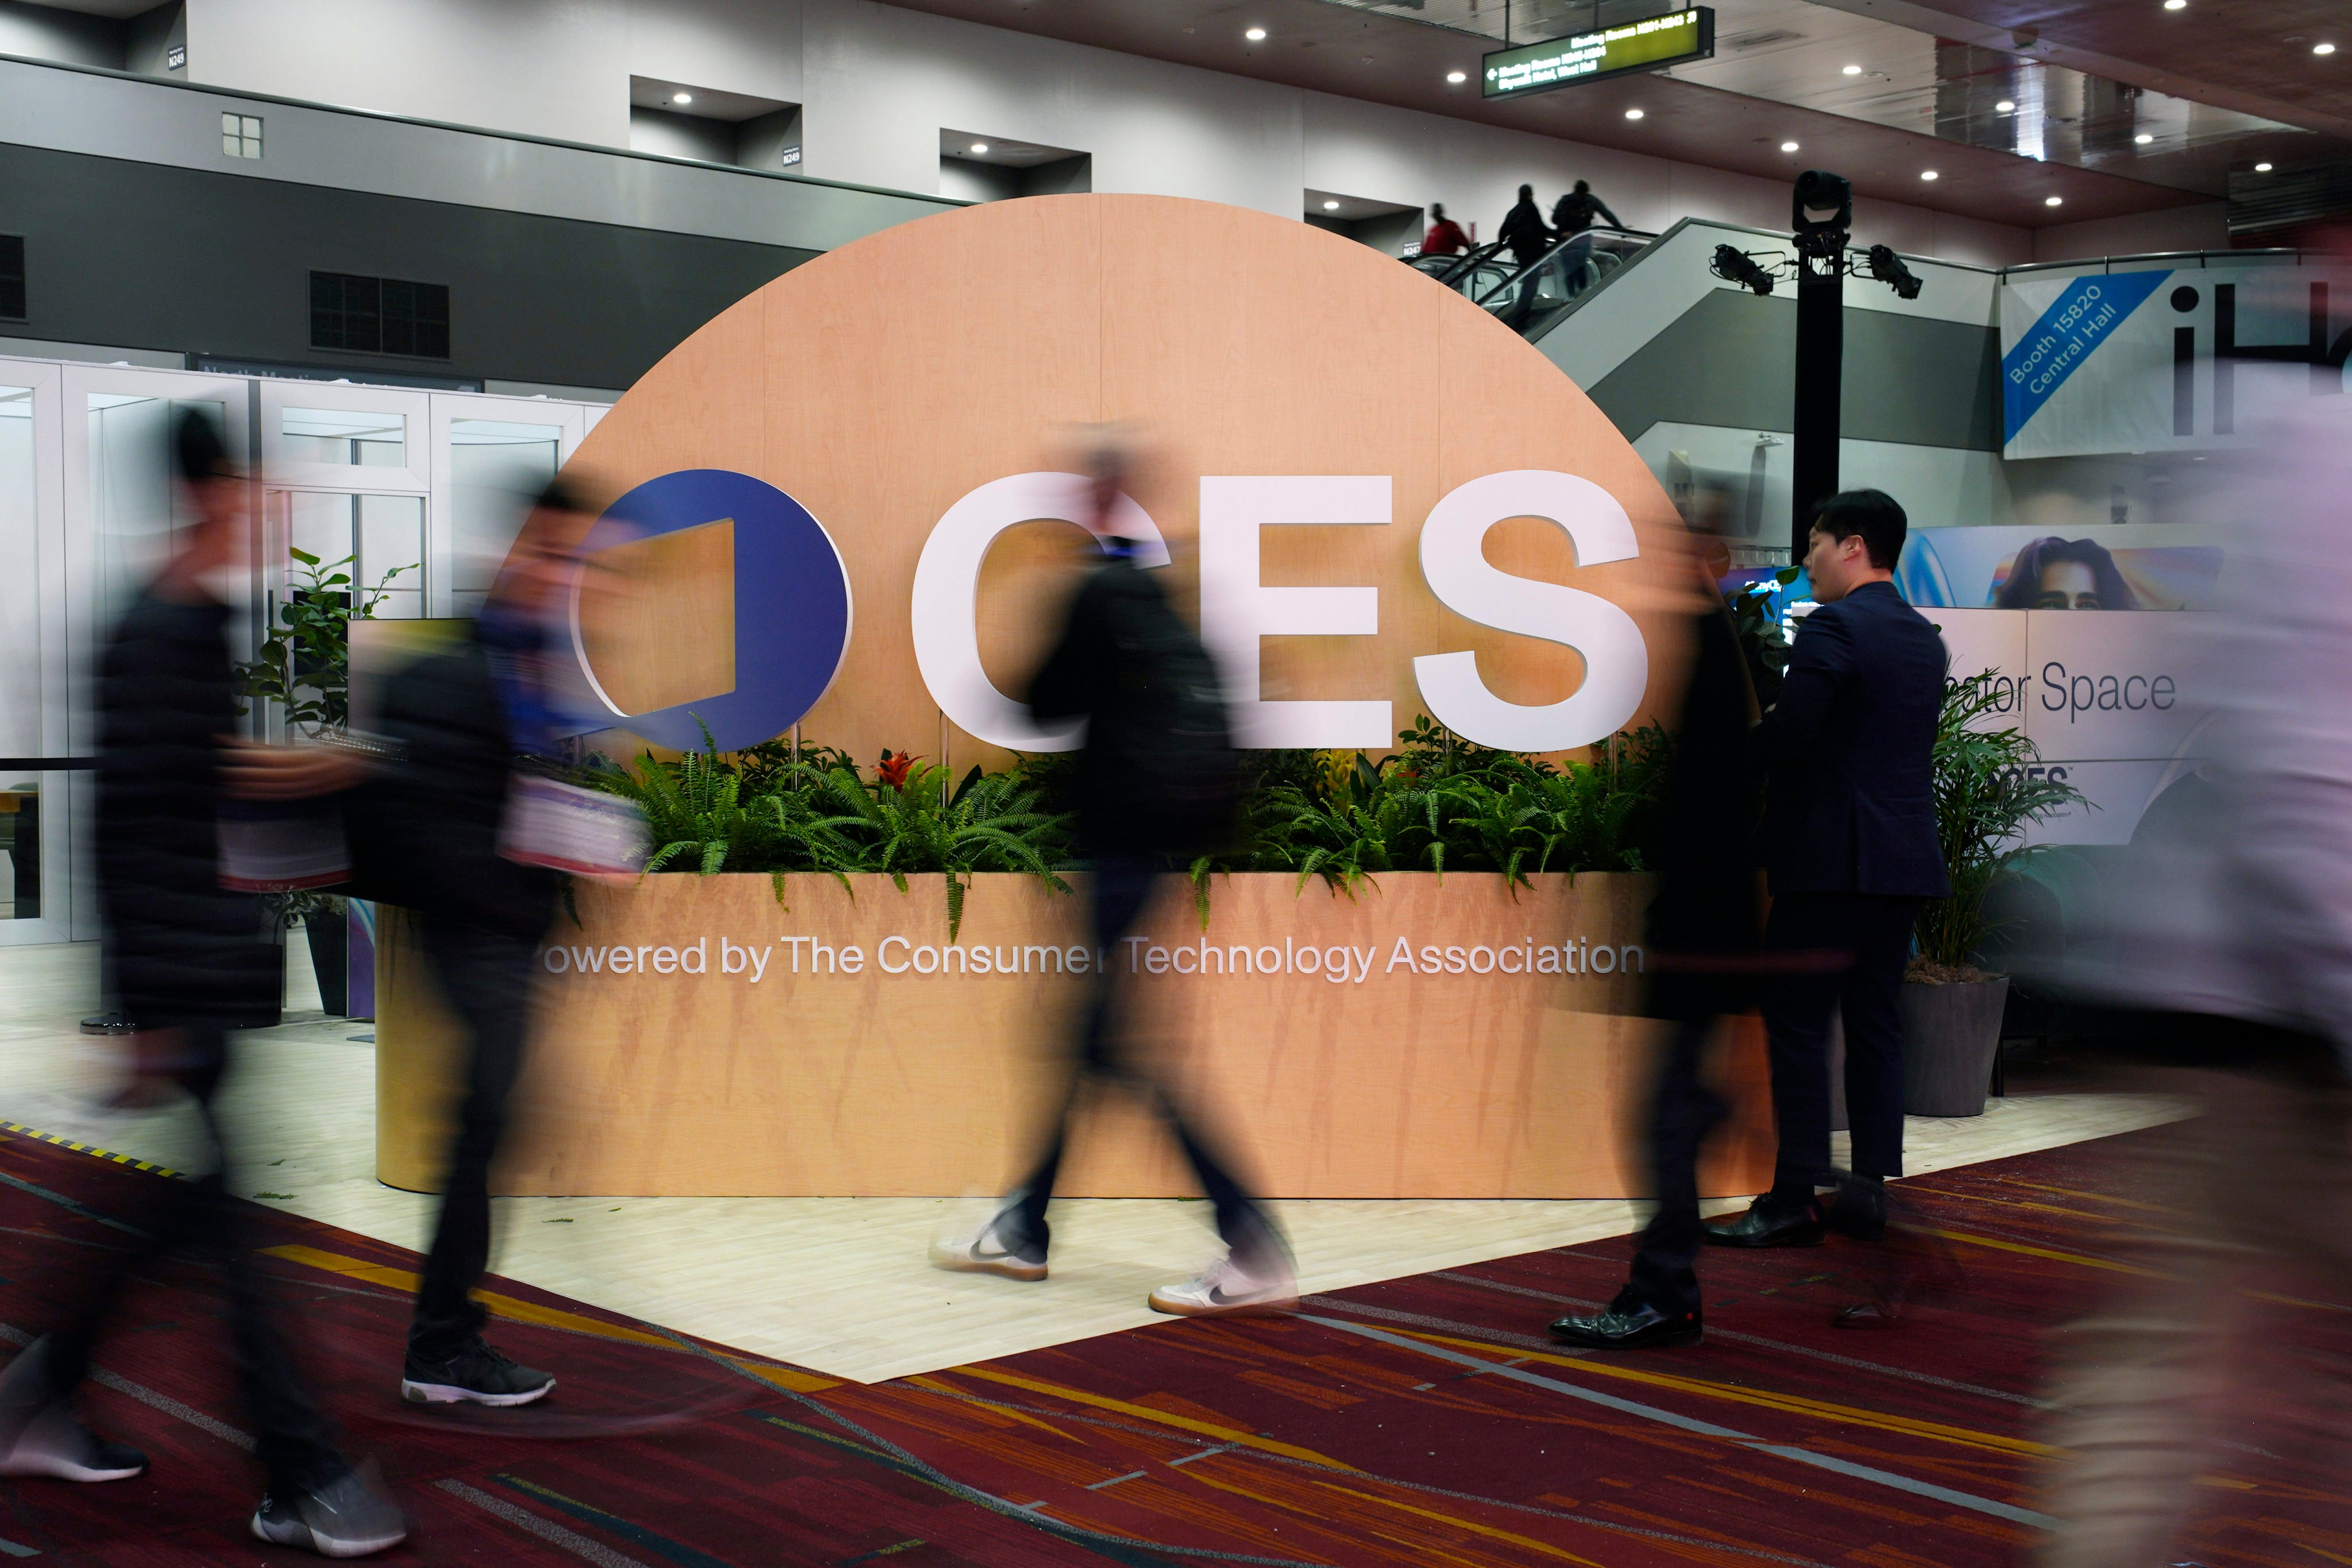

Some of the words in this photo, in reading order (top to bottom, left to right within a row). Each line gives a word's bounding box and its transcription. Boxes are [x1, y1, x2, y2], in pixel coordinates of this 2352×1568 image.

[169, 53, 184, 67] N249
[783, 152, 800, 164] N249
[1404, 246, 1421, 256] N247
[2010, 335, 2056, 384] Booth
[2053, 285, 2102, 333] 15820
[2030, 336, 2084, 394] Central
[2081, 303, 2117, 338] Hall
[2170, 281, 2352, 437] iH
[911, 469, 1650, 752] CES
[2042, 662, 2176, 724] Space
[536, 937, 706, 974] owered
[721, 937, 772, 983] by
[781, 936, 864, 974] The
[878, 936, 1104, 974] Consumer
[1120, 936, 1377, 983] Technology
[1385, 936, 1644, 974] Association
